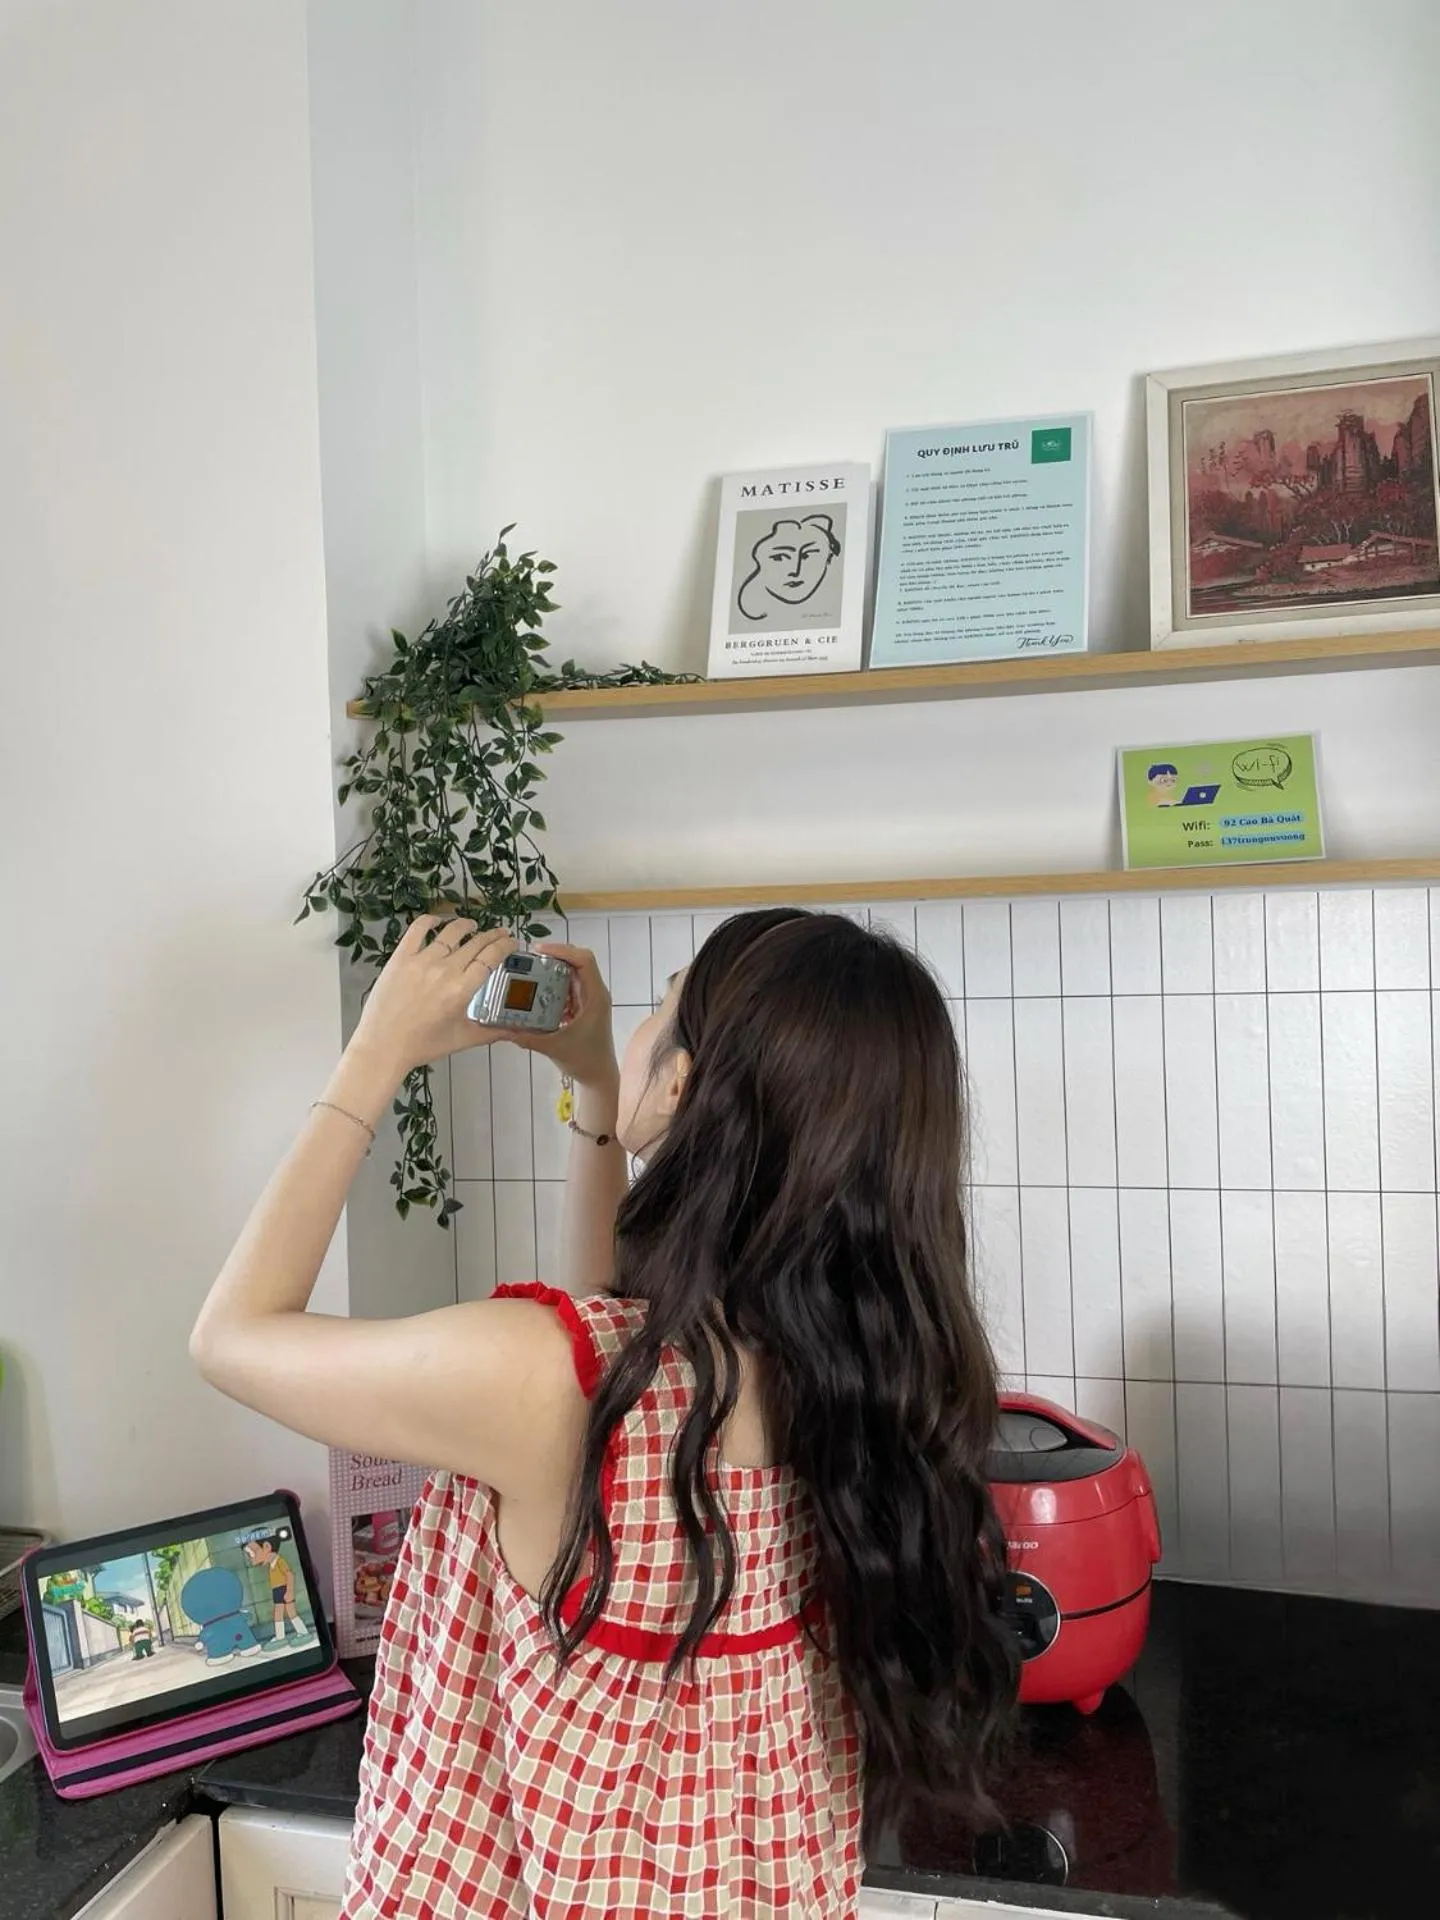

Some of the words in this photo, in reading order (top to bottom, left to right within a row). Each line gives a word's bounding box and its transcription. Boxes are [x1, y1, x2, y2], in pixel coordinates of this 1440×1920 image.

[917, 448, 940, 459] QUY
[942, 445, 970, 457] ĐỊNH
[972, 443, 996, 453] LƯU
[740, 477, 846, 497] MATISSE
[725, 638, 799, 649] BERGGRUEN
[804, 637, 812, 645] &
[817, 636, 839, 644] CIE
[1016, 637, 1049, 649] Thank
[1050, 634, 1075, 647] You
[1182, 820, 1211, 831] Wifi:
[1239, 817, 1258, 826] Cao
[1187, 839, 1214, 848] Pass:
[352, 1468, 402, 1491] Bread
